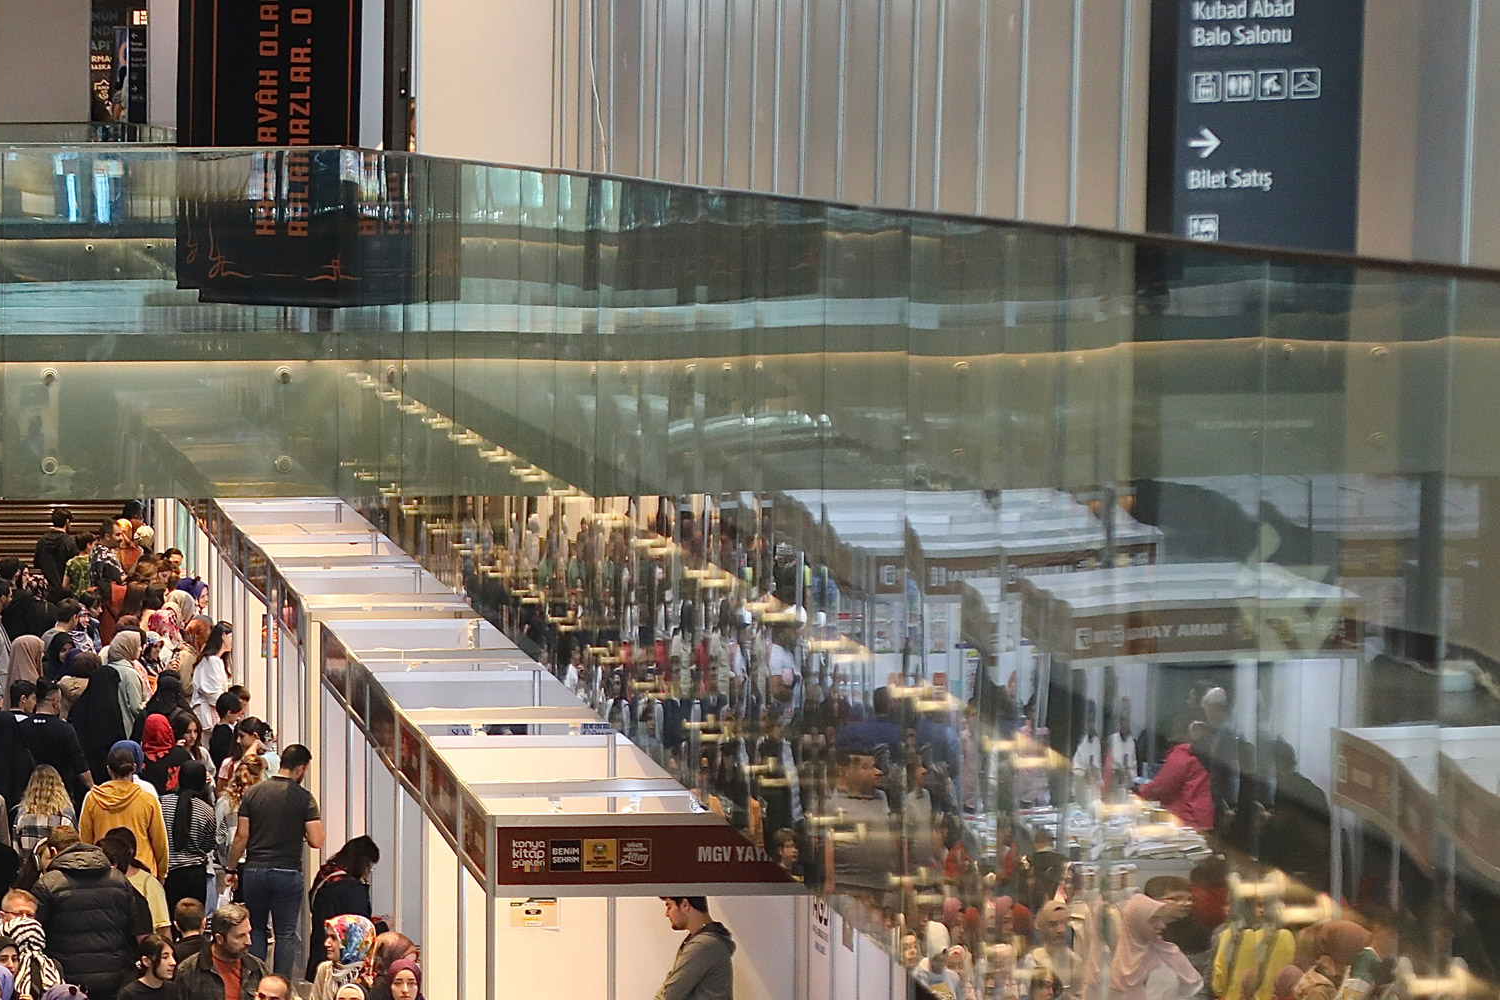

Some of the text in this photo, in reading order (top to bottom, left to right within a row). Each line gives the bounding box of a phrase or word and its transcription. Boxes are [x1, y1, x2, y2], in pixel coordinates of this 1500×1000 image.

[1191, 25, 1292, 47] Balo Salonu
[1186, 168, 1273, 191] Bilet Satış
[512, 839, 546, 850] konya
[512, 848, 545, 861] kitap
[552, 847, 580, 856] BENİM
[698, 846, 732, 861] MGV
[512, 859, 546, 870] günleri
[552, 856, 580, 865] ŞEHRİM
